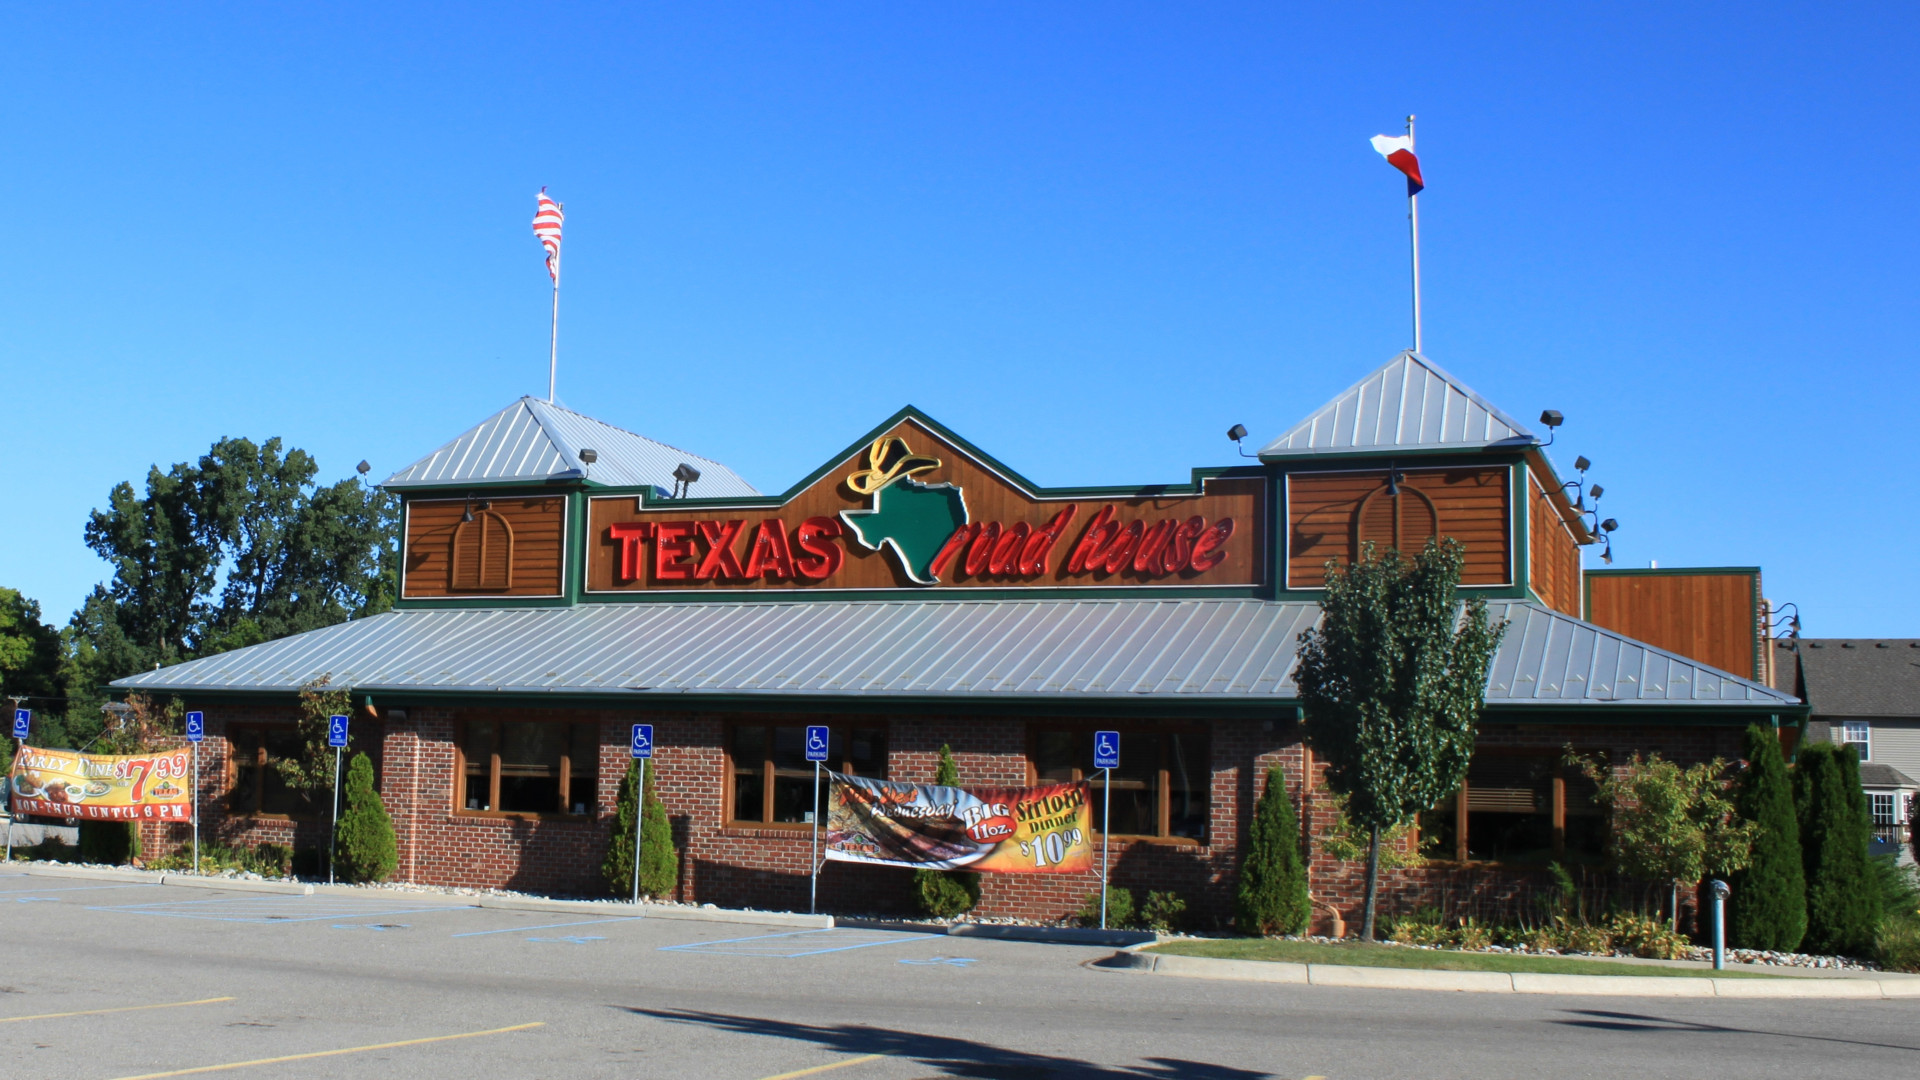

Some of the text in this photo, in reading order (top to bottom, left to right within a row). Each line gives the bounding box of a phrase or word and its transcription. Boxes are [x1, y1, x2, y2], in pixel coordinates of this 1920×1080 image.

[610, 503, 1234, 580] TEXAS road house
[19, 748, 71, 771] EARLY
[89, 805, 139, 818] UNTIL
[144, 805, 152, 818] 6
[963, 803, 1010, 829] BIG
[1015, 787, 1084, 822] Sirloin
[972, 823, 1012, 839] 11oz.
[1029, 810, 1077, 834] Dinner
